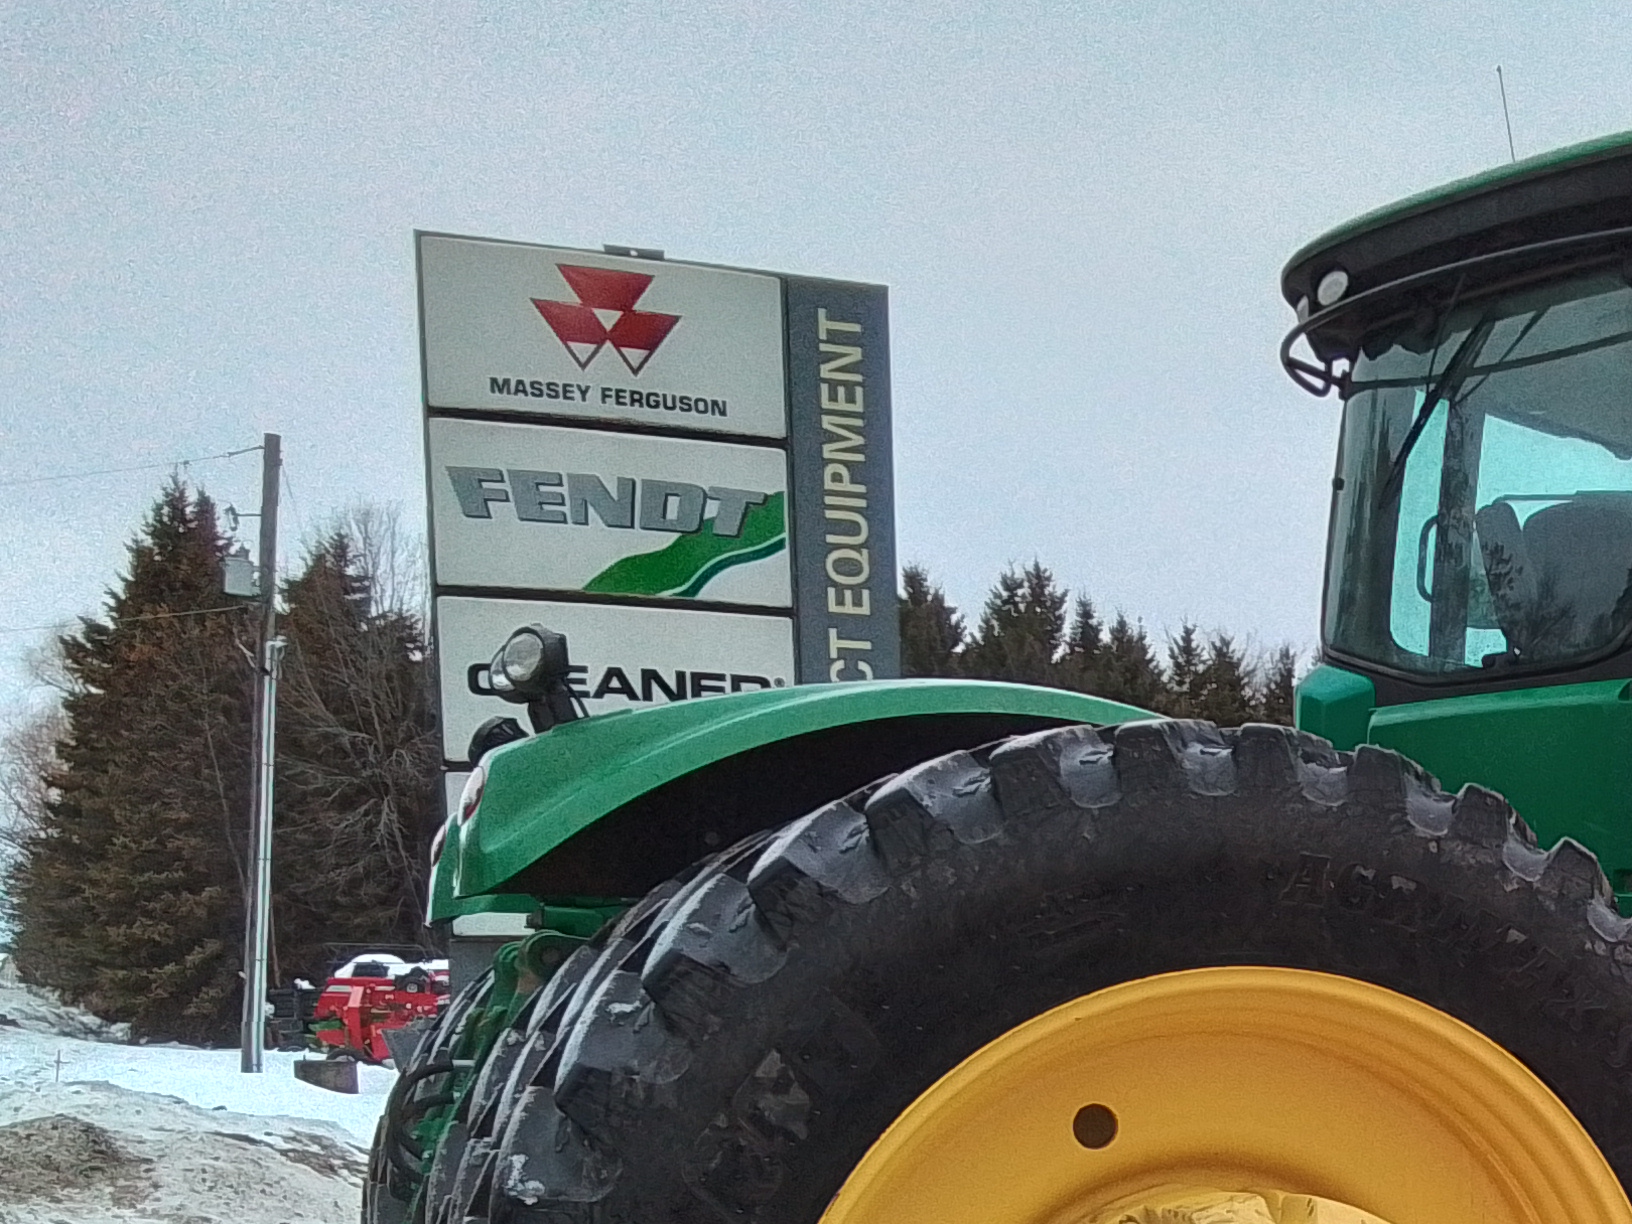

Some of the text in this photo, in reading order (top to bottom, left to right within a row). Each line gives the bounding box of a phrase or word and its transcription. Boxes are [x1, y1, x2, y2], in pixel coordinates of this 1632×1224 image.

[489, 376, 727, 416] MASSEY FERGUSON
[818, 308, 871, 615] EQUIPMENT
[445, 466, 768, 537] FENDT
